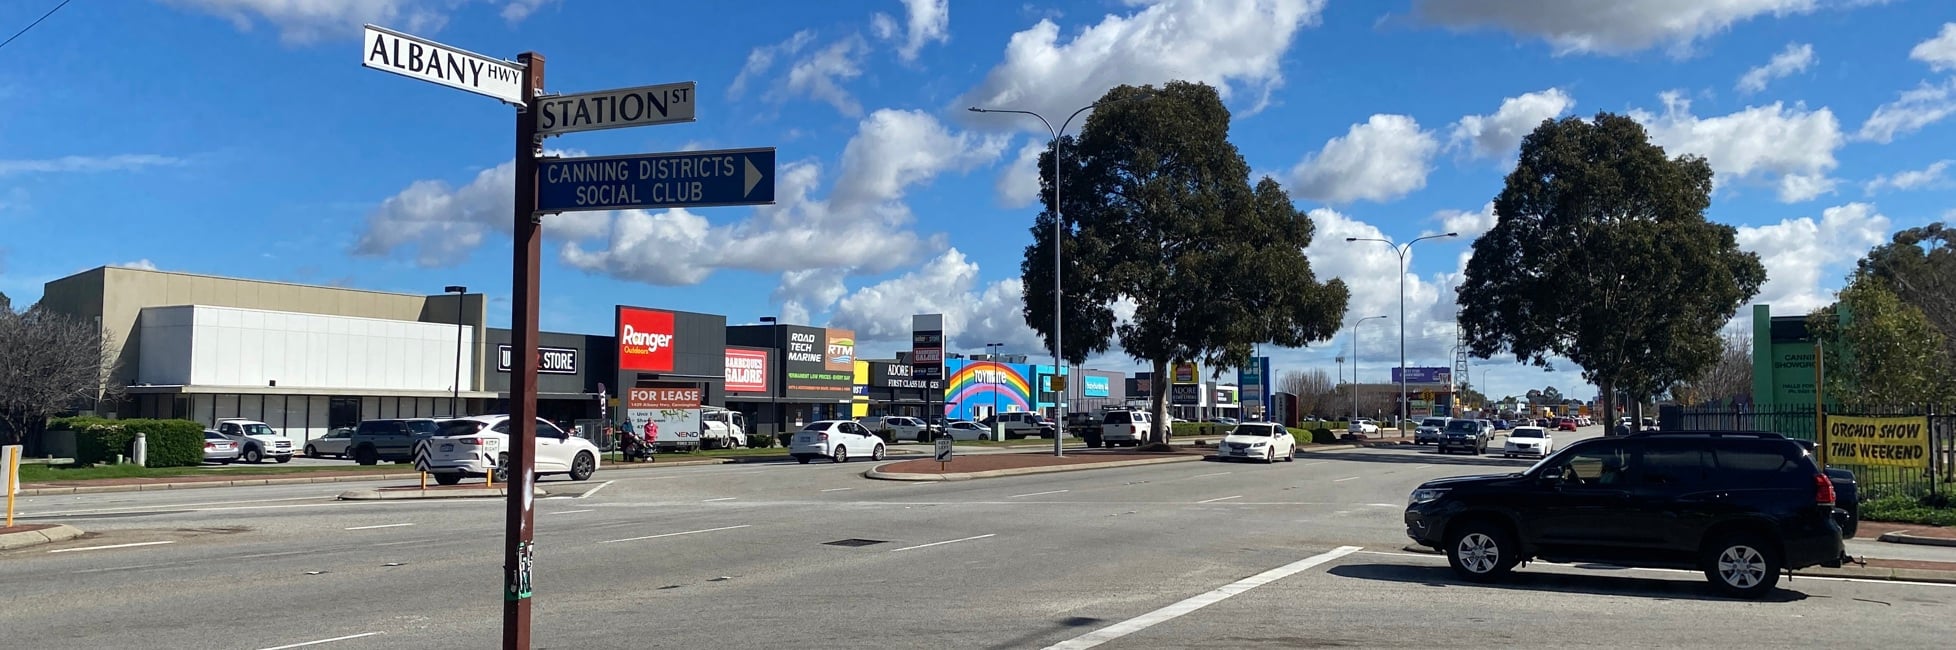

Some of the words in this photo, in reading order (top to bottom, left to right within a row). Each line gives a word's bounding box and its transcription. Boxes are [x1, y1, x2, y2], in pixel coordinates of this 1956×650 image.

[369, 33, 484, 88] ALBANY
[488, 63, 520, 85] HWY
[542, 90, 668, 129] STATION
[672, 87, 690, 104] ST
[547, 161, 629, 184] CANNING
[639, 156, 735, 180] DISTRICTS
[576, 184, 642, 206] SOCIAL
[652, 181, 703, 203] CLUB
[622, 324, 673, 353] Ranger
[791, 332, 815, 343] ROAD
[623, 345, 649, 355] Outdoors
[790, 342, 813, 352] TECH
[827, 344, 853, 356] RTM
[543, 351, 574, 370] STORE
[725, 356, 763, 369] BARBEQUES
[788, 352, 822, 363] MARINE
[725, 368, 762, 384] GALORE
[887, 364, 909, 377] ADORE
[888, 378, 902, 387] FIRST
[902, 379, 917, 388] CLASS
[918, 380, 939, 389] LOUGES
[1172, 386, 1196, 394] ADORE
[631, 390, 657, 401] FOR
[660, 390, 698, 401] LEASE
[1831, 422, 1876, 438] ORCHID
[1878, 423, 1921, 439] SHOW
[1831, 442, 1857, 457] THIS
[1859, 443, 1924, 460] WEEKEND
